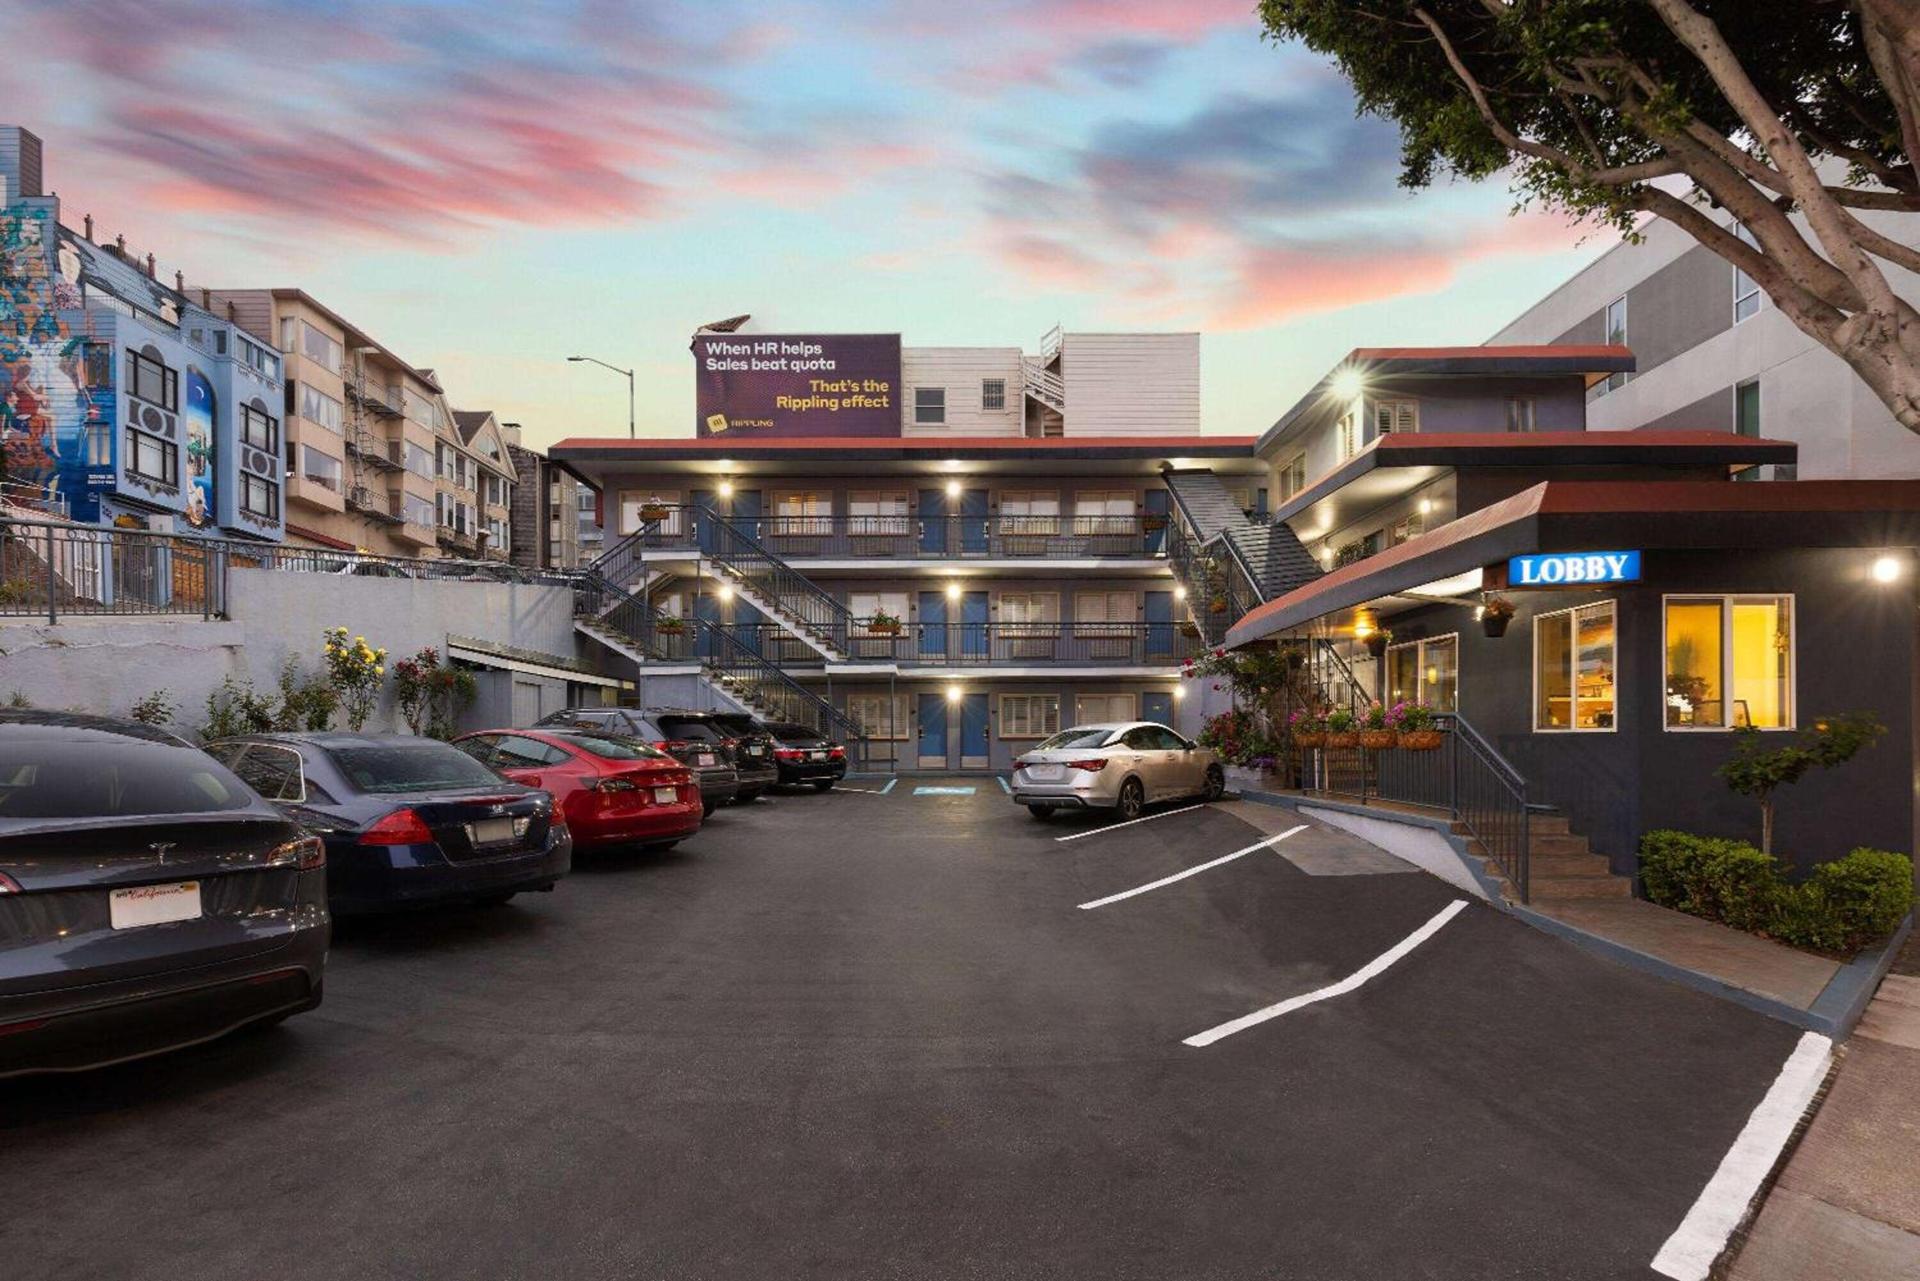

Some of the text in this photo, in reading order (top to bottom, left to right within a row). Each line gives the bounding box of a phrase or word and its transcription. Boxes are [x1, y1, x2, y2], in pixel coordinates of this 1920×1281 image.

[706, 341, 822, 357] When HR helps
[706, 357, 836, 373] Sales beat quota
[810, 380, 889, 392] That's the
[776, 395, 889, 411] Rippling effect
[1520, 555, 1628, 584] LOBBY
